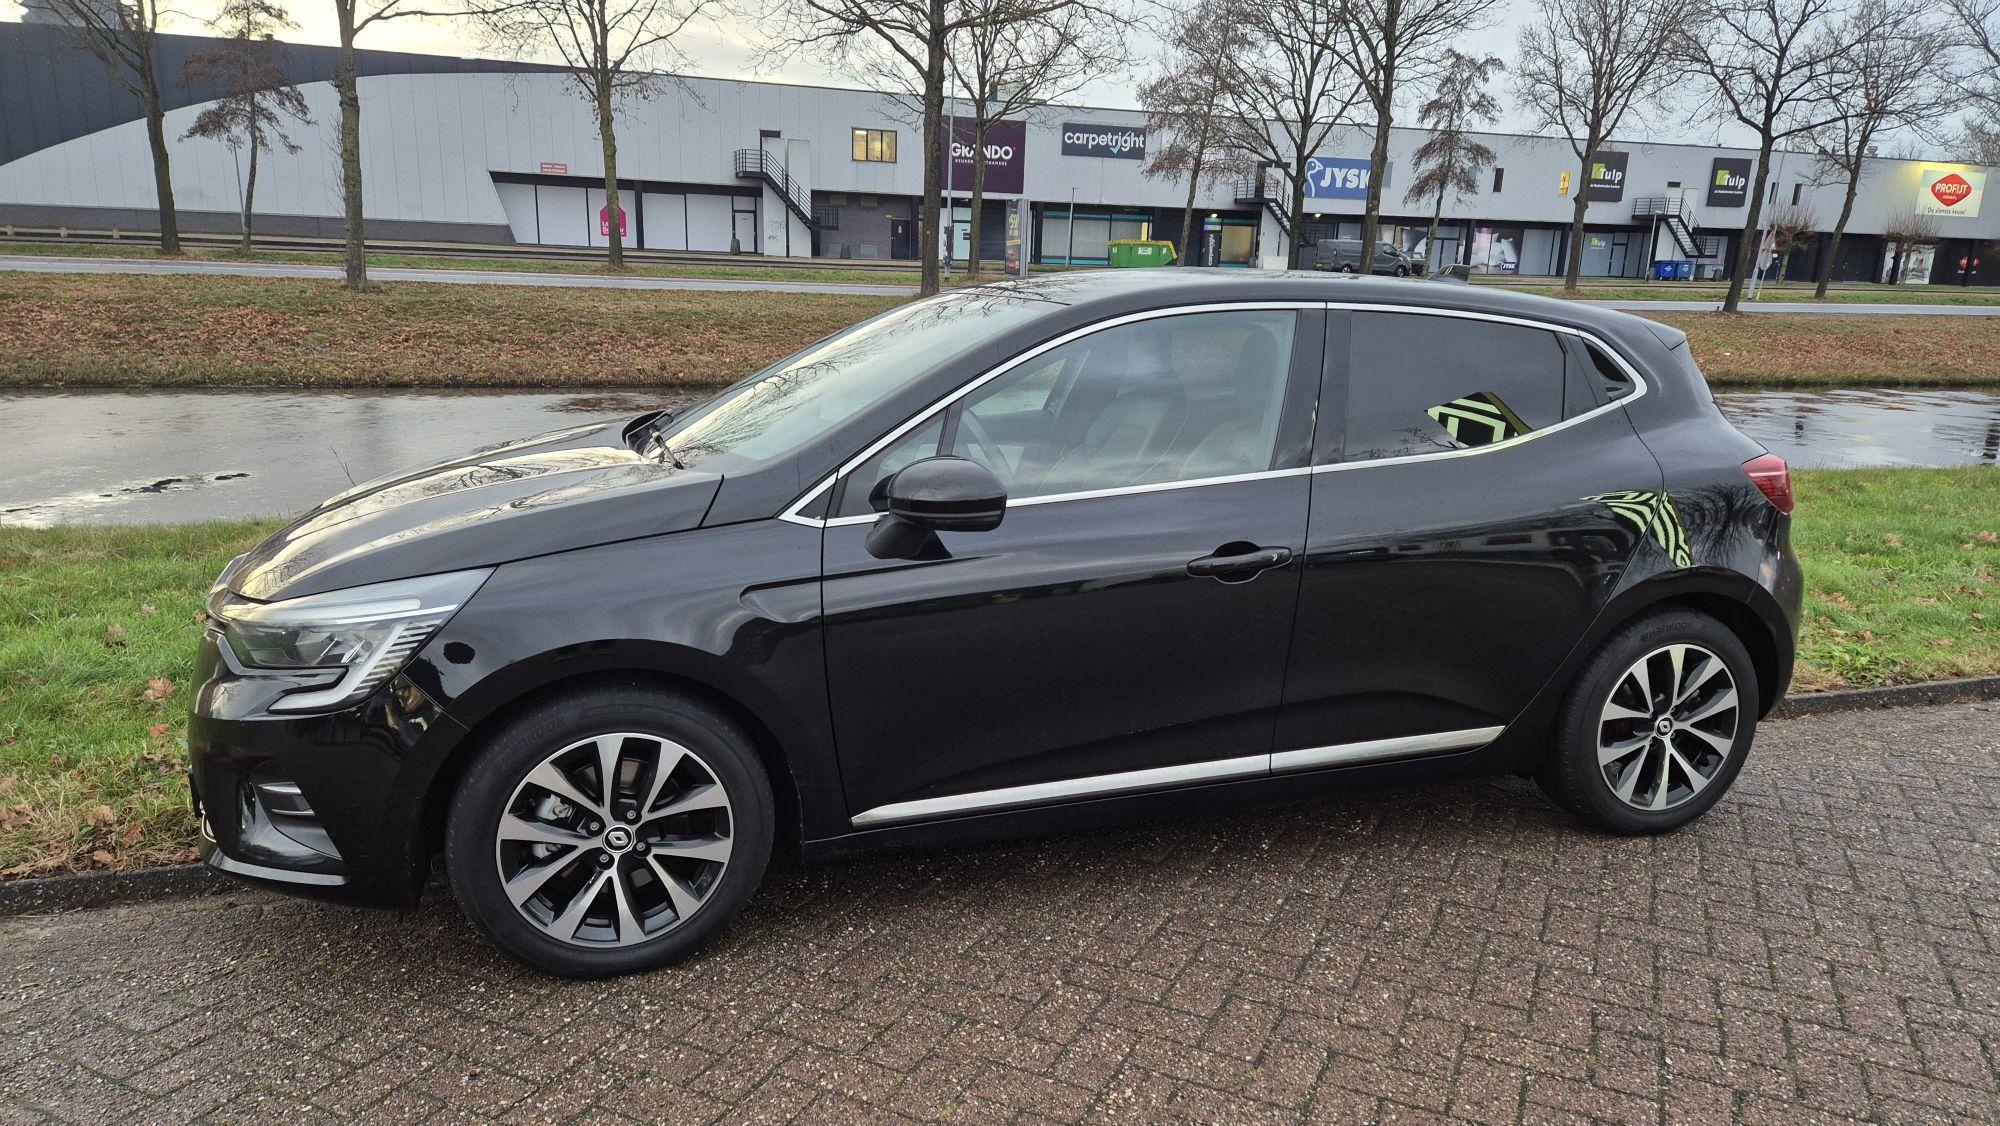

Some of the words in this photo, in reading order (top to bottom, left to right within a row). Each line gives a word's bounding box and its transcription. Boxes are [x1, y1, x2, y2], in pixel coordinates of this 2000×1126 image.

[1064, 131, 1145, 152] carpetright
[1320, 167, 1371, 189] JYSK
[1600, 168, 1622, 184] Tulp
[1723, 174, 1746, 190] Tulp
[1935, 183, 1969, 194] PROFIJT
